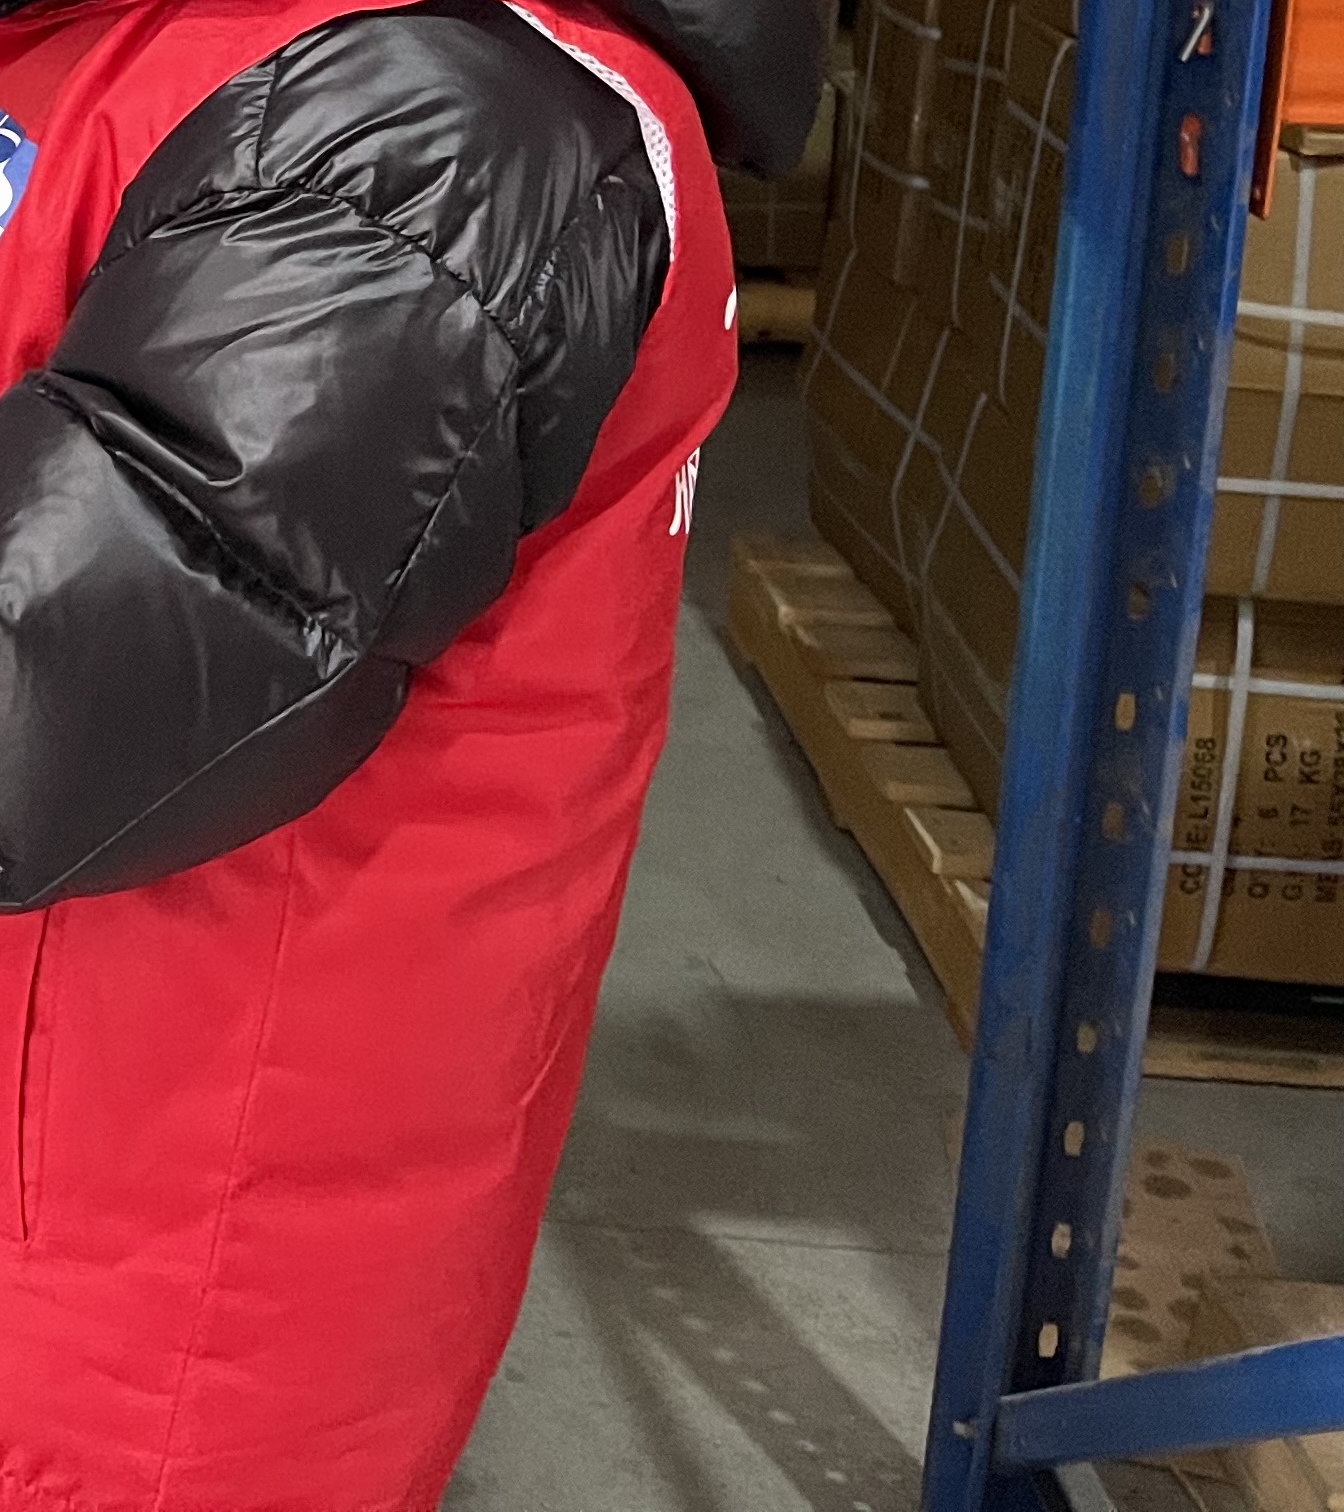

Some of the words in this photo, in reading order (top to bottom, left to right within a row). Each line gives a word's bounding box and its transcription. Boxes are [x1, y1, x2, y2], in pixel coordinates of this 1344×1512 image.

[1264, 734, 1287, 783] PCS
[1298, 749, 1321, 785] KG
[1289, 803, 1312, 827] 17
